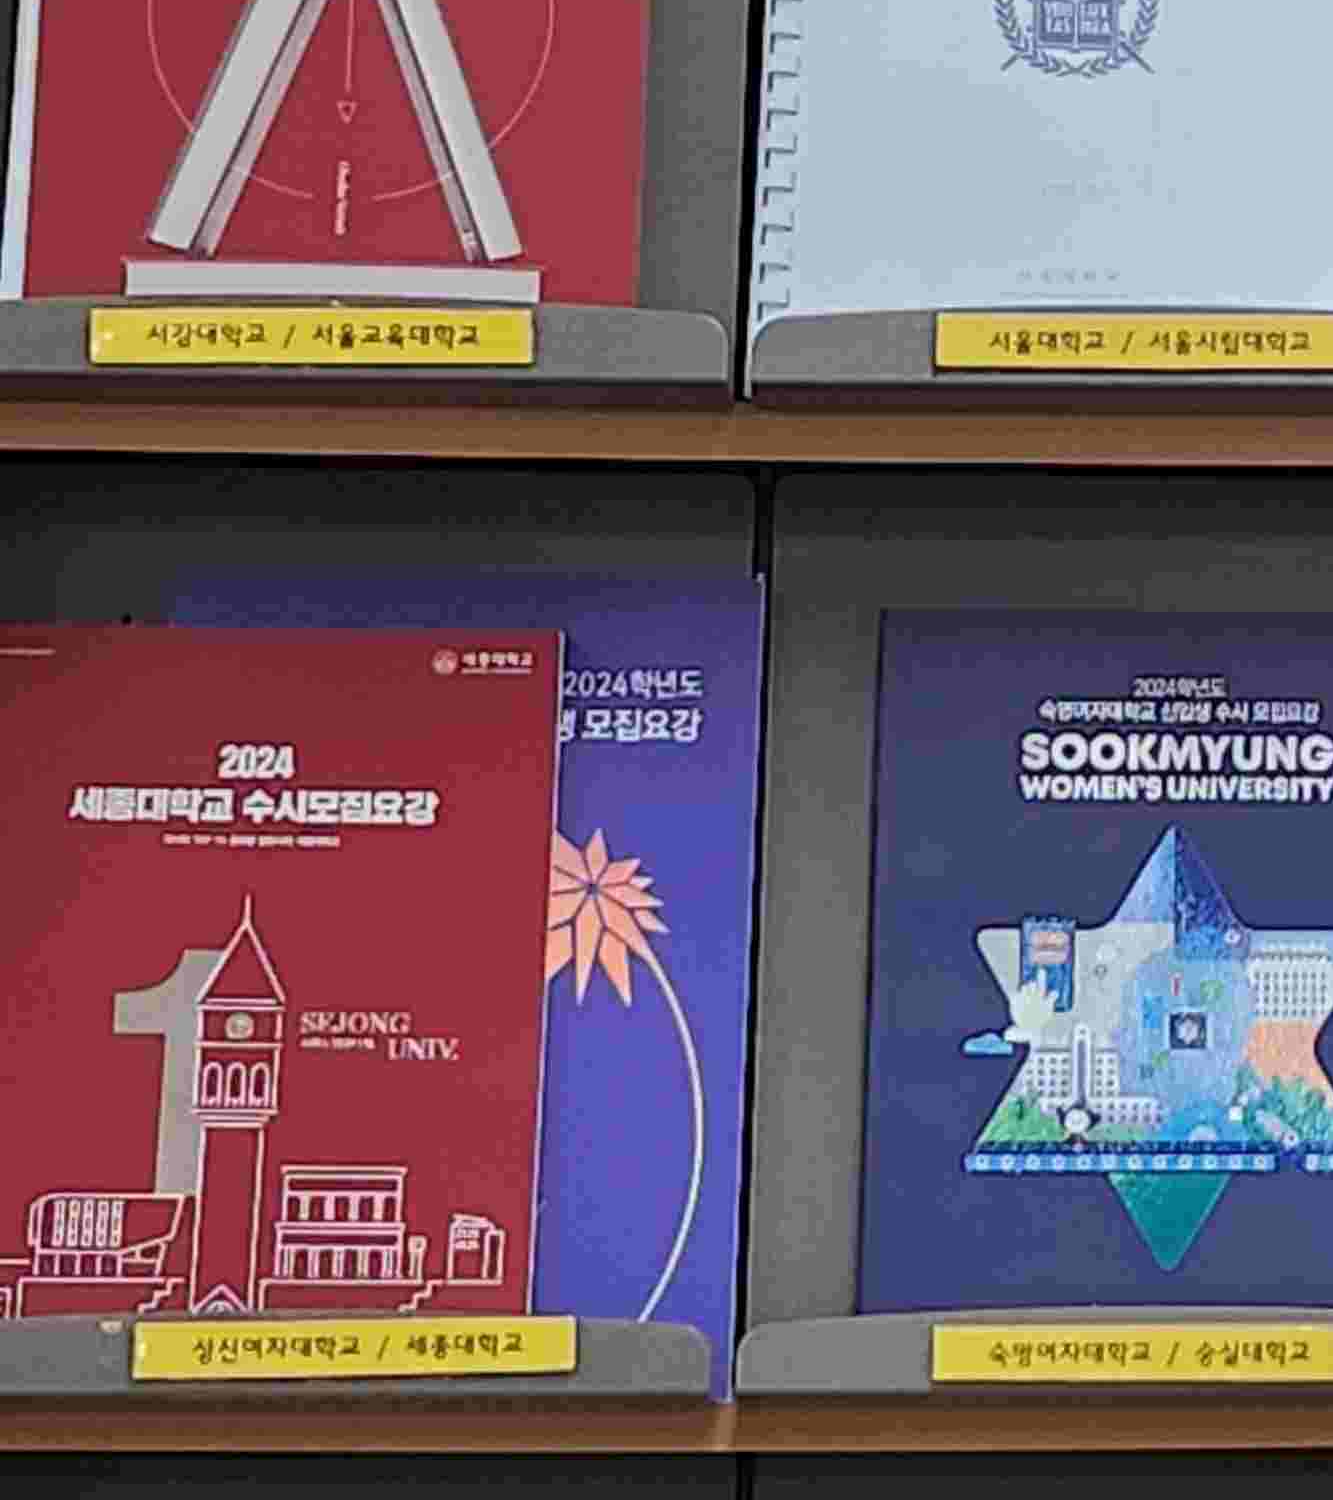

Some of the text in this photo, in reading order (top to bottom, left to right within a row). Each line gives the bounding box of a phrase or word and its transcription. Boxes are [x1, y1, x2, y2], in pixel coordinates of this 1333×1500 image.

[146, 323, 268, 349] 서강대학교
[988, 330, 1107, 356] 서울대학교
[1149, 330, 1312, 357] 서울시립대학교
[564, 669, 702, 700] 2024학년도
[581, 708, 702, 743] 모집요강
[217, 743, 296, 779] 2024
[1018, 774, 1162, 801] WOMEN'S
[69, 786, 440, 825] 세종대학교 수시모집요강
[300, 1010, 412, 1035] SEJONG
[192, 1333, 361, 1364] 성신여자대학교
[407, 1331, 526, 1358] 세종대학교
